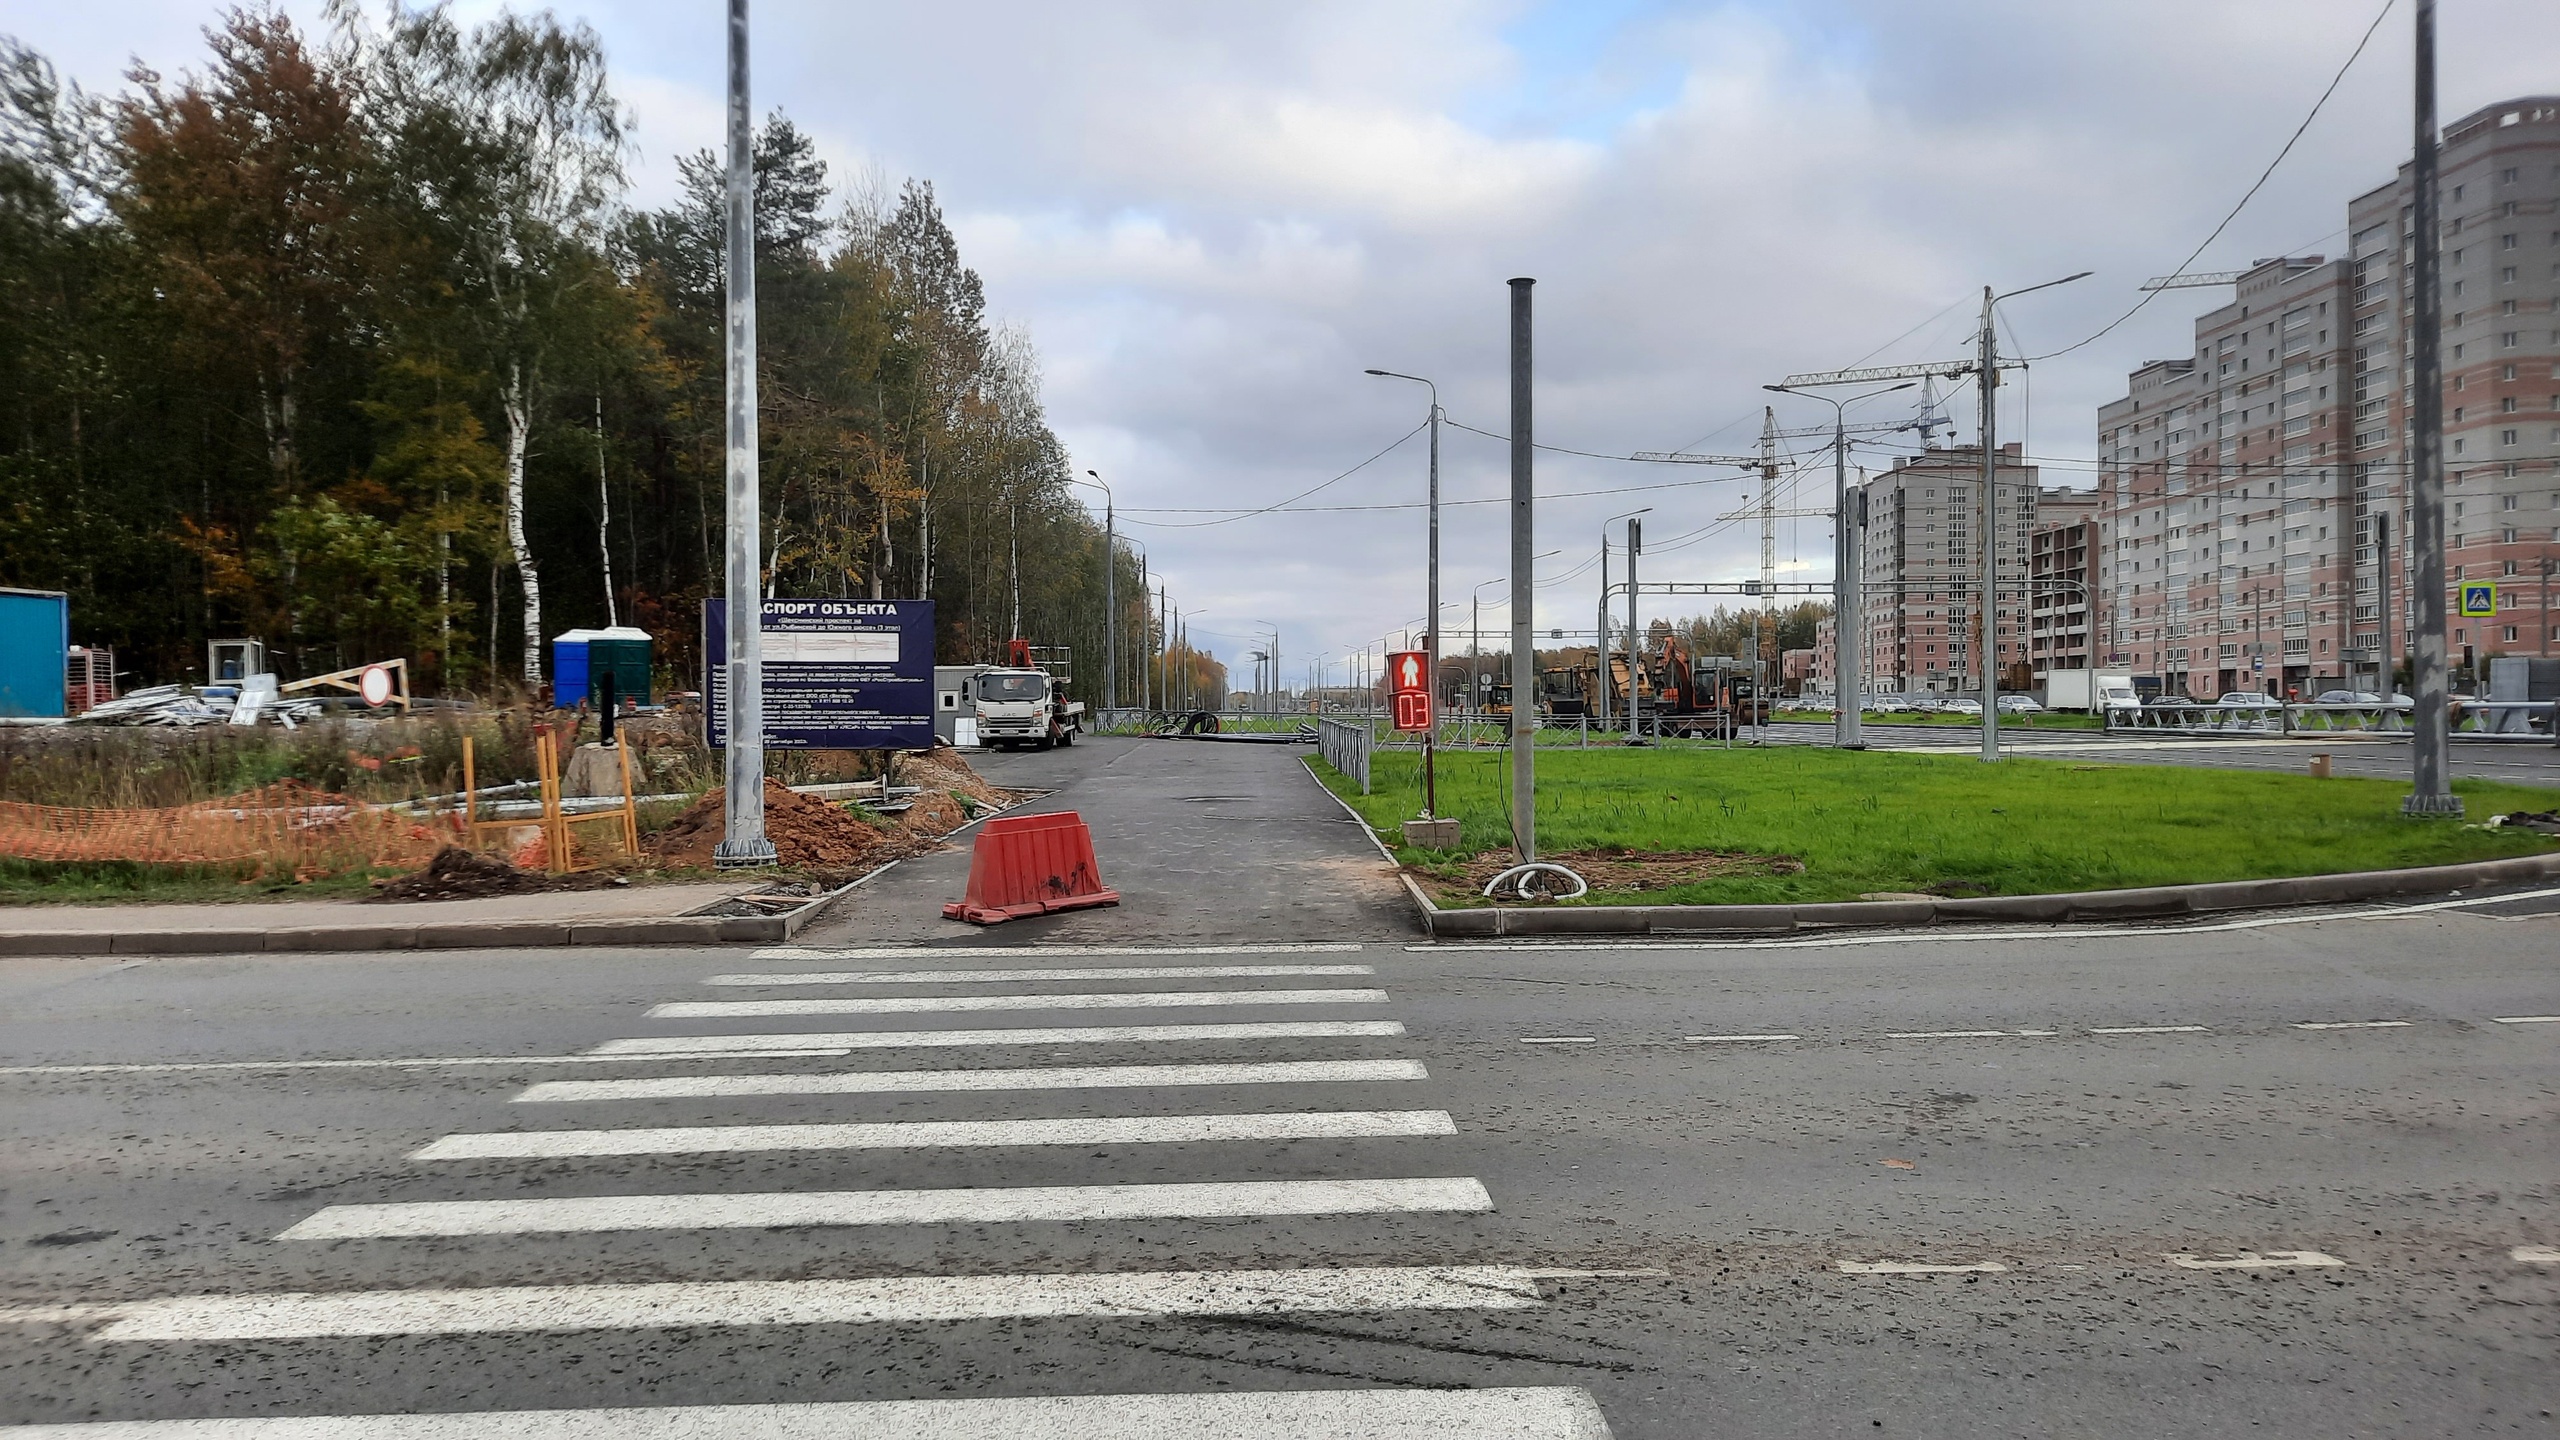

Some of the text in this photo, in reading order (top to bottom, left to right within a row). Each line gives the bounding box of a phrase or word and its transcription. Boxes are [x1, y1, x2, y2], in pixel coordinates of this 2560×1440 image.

[760, 603, 898, 615] СПОРТ ОБЪЕКТА
[1398, 694, 1429, 727] 03
